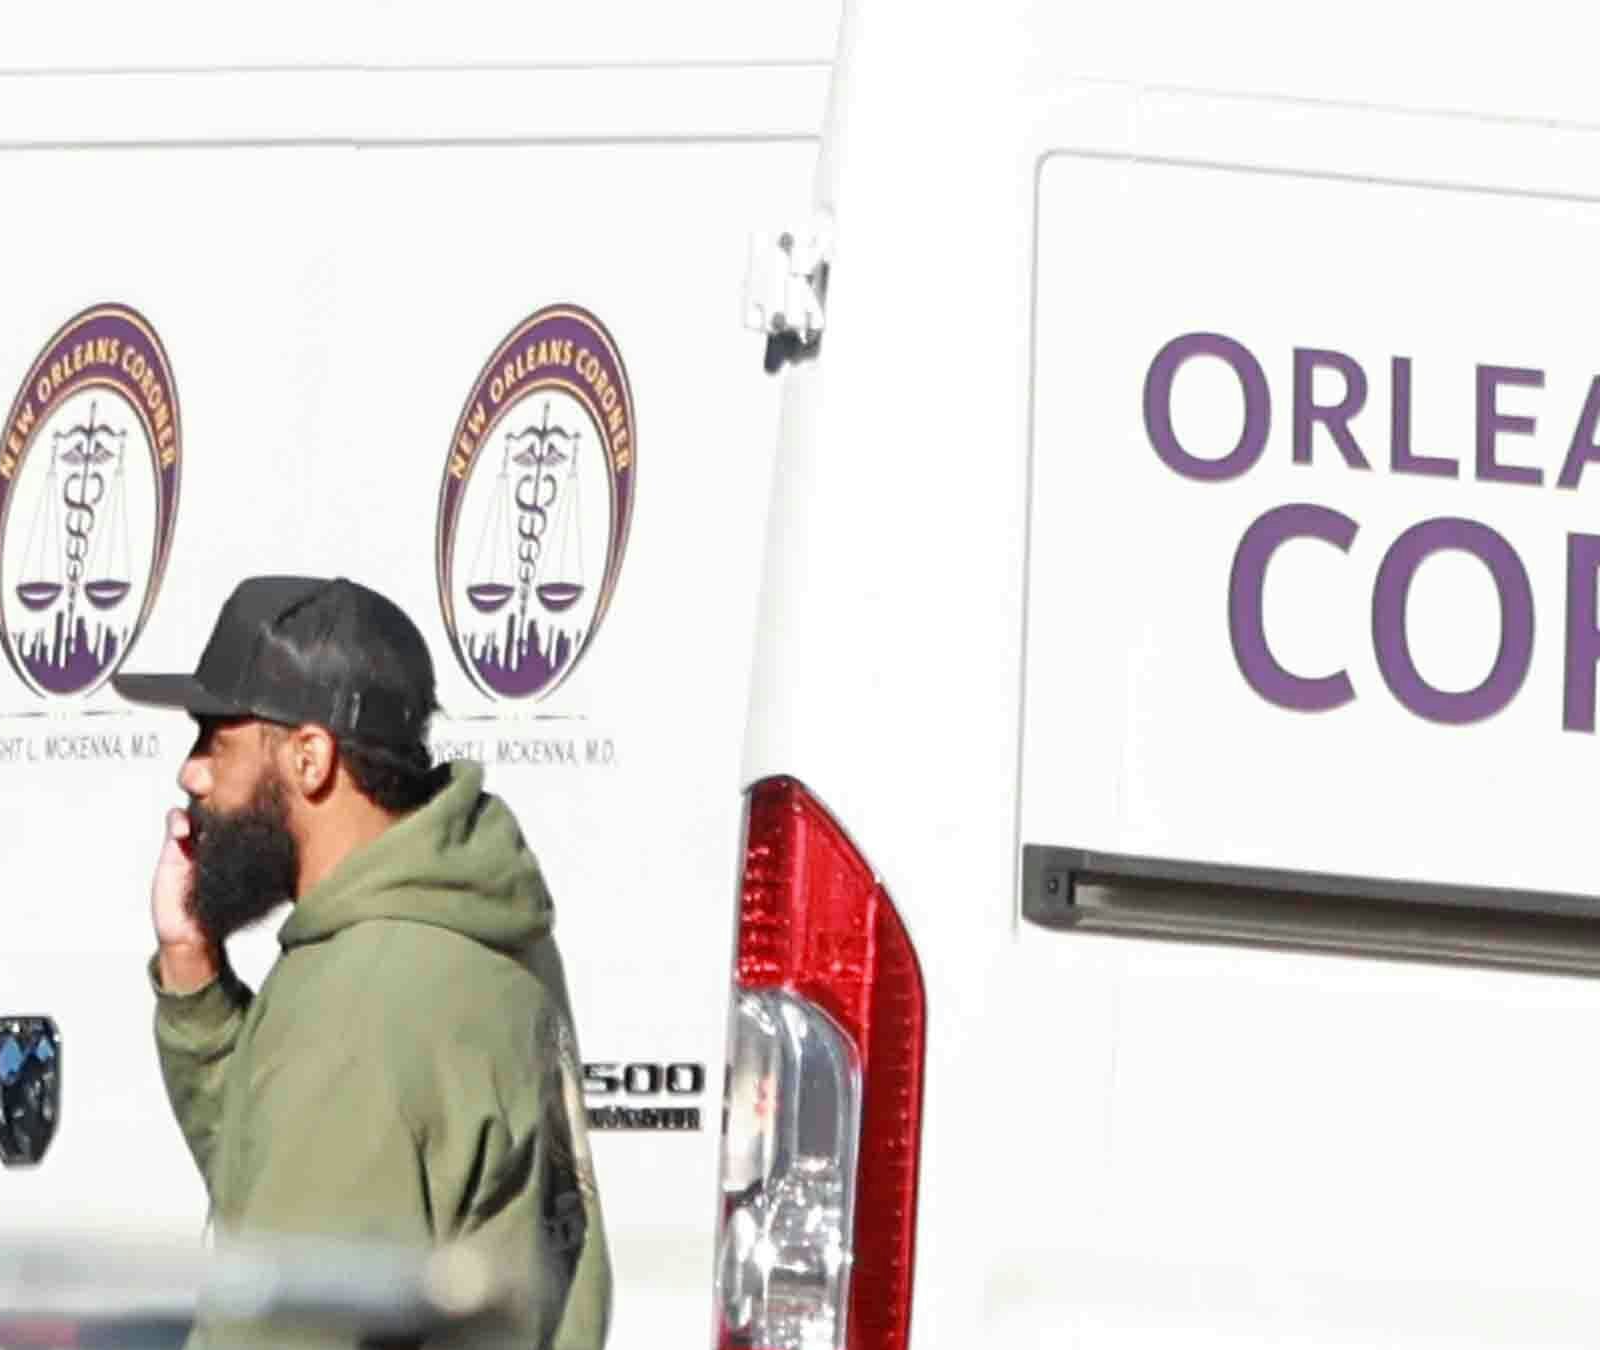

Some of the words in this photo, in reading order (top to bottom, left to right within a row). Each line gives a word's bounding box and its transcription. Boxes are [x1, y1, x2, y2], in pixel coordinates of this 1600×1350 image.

[0, 402, 35, 479] NEW
[36, 337, 121, 404] ORLEANS
[121, 346, 177, 470] CORONER
[450, 402, 487, 480] NEW
[489, 339, 575, 404] ORLEANS
[575, 348, 631, 473] CORONER
